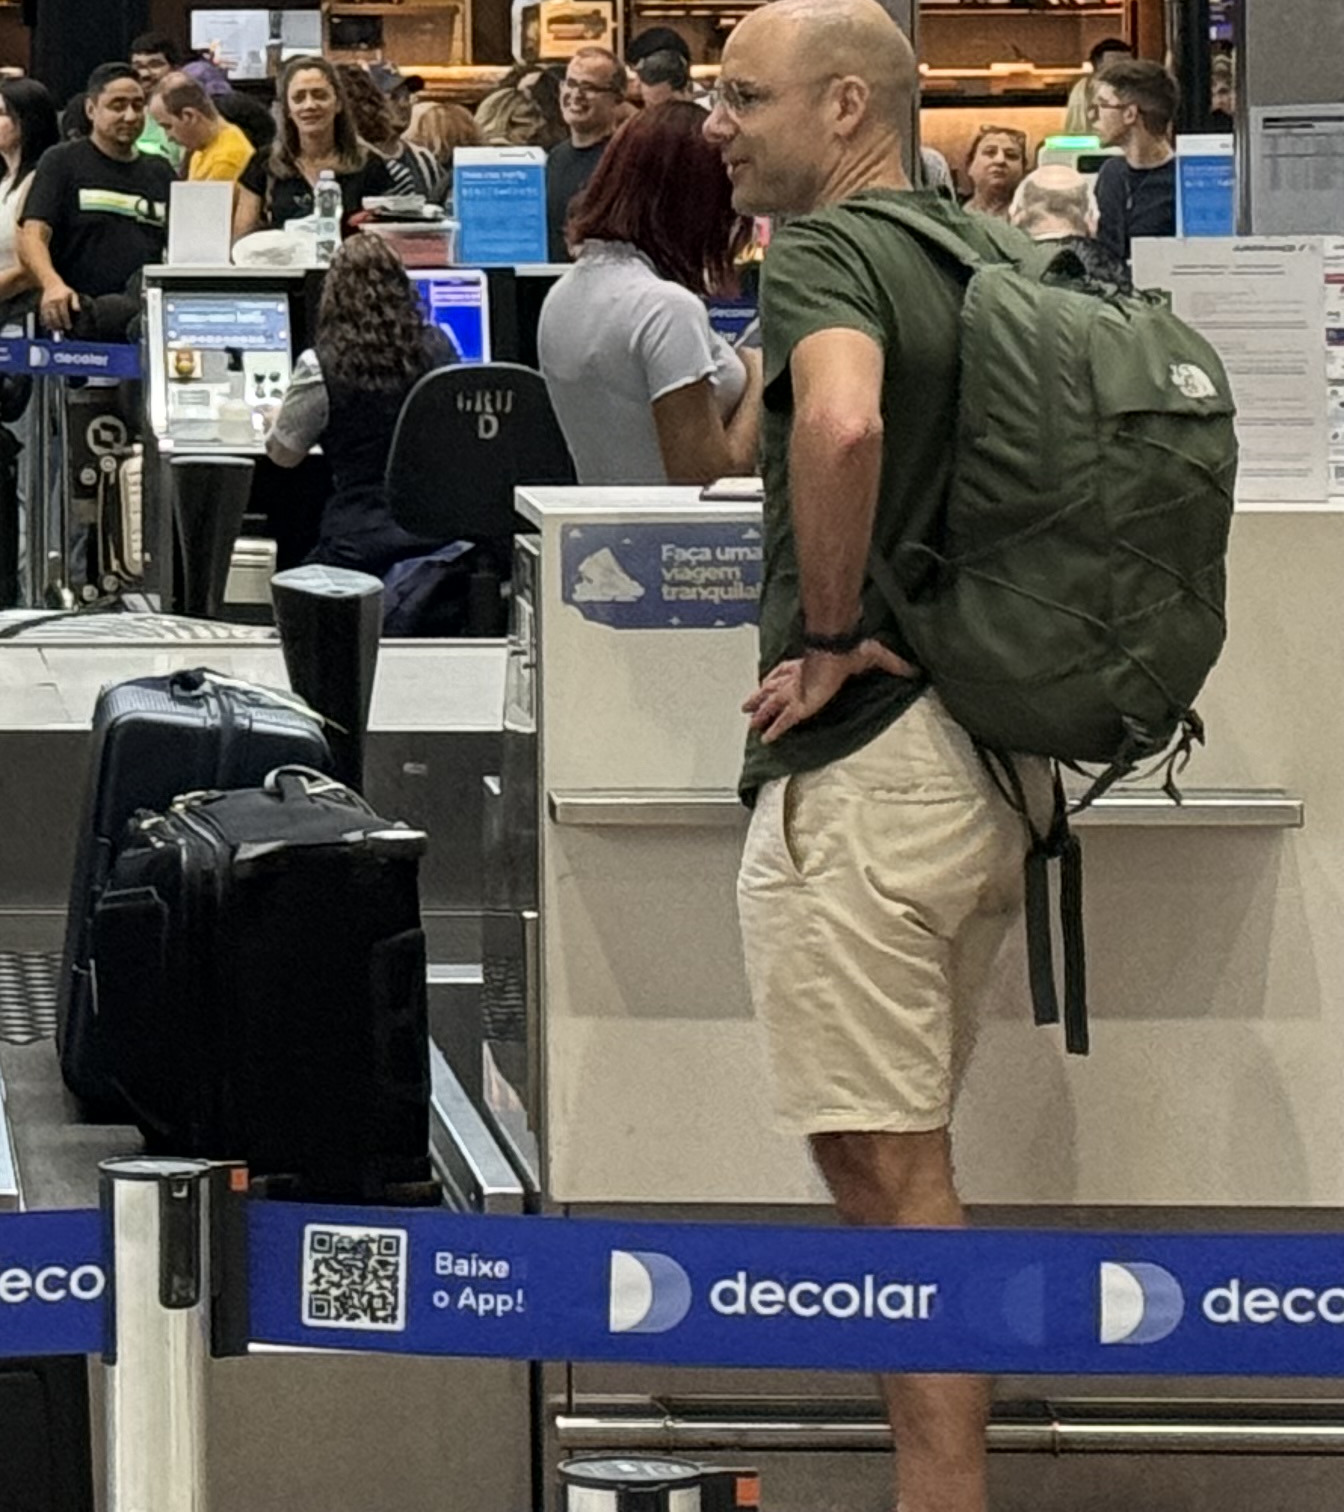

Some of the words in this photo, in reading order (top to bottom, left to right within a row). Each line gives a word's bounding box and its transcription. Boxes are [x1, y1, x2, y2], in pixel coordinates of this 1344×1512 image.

[477, 413, 500, 439] D
[661, 544, 711, 567] Faça
[662, 563, 742, 584] viagem
[434, 1251, 510, 1278] Baixe
[432, 1291, 450, 1309] o
[457, 1287, 525, 1318] App!
[709, 1271, 939, 1320] decolar
[1202, 1279, 1344, 1325] deco
